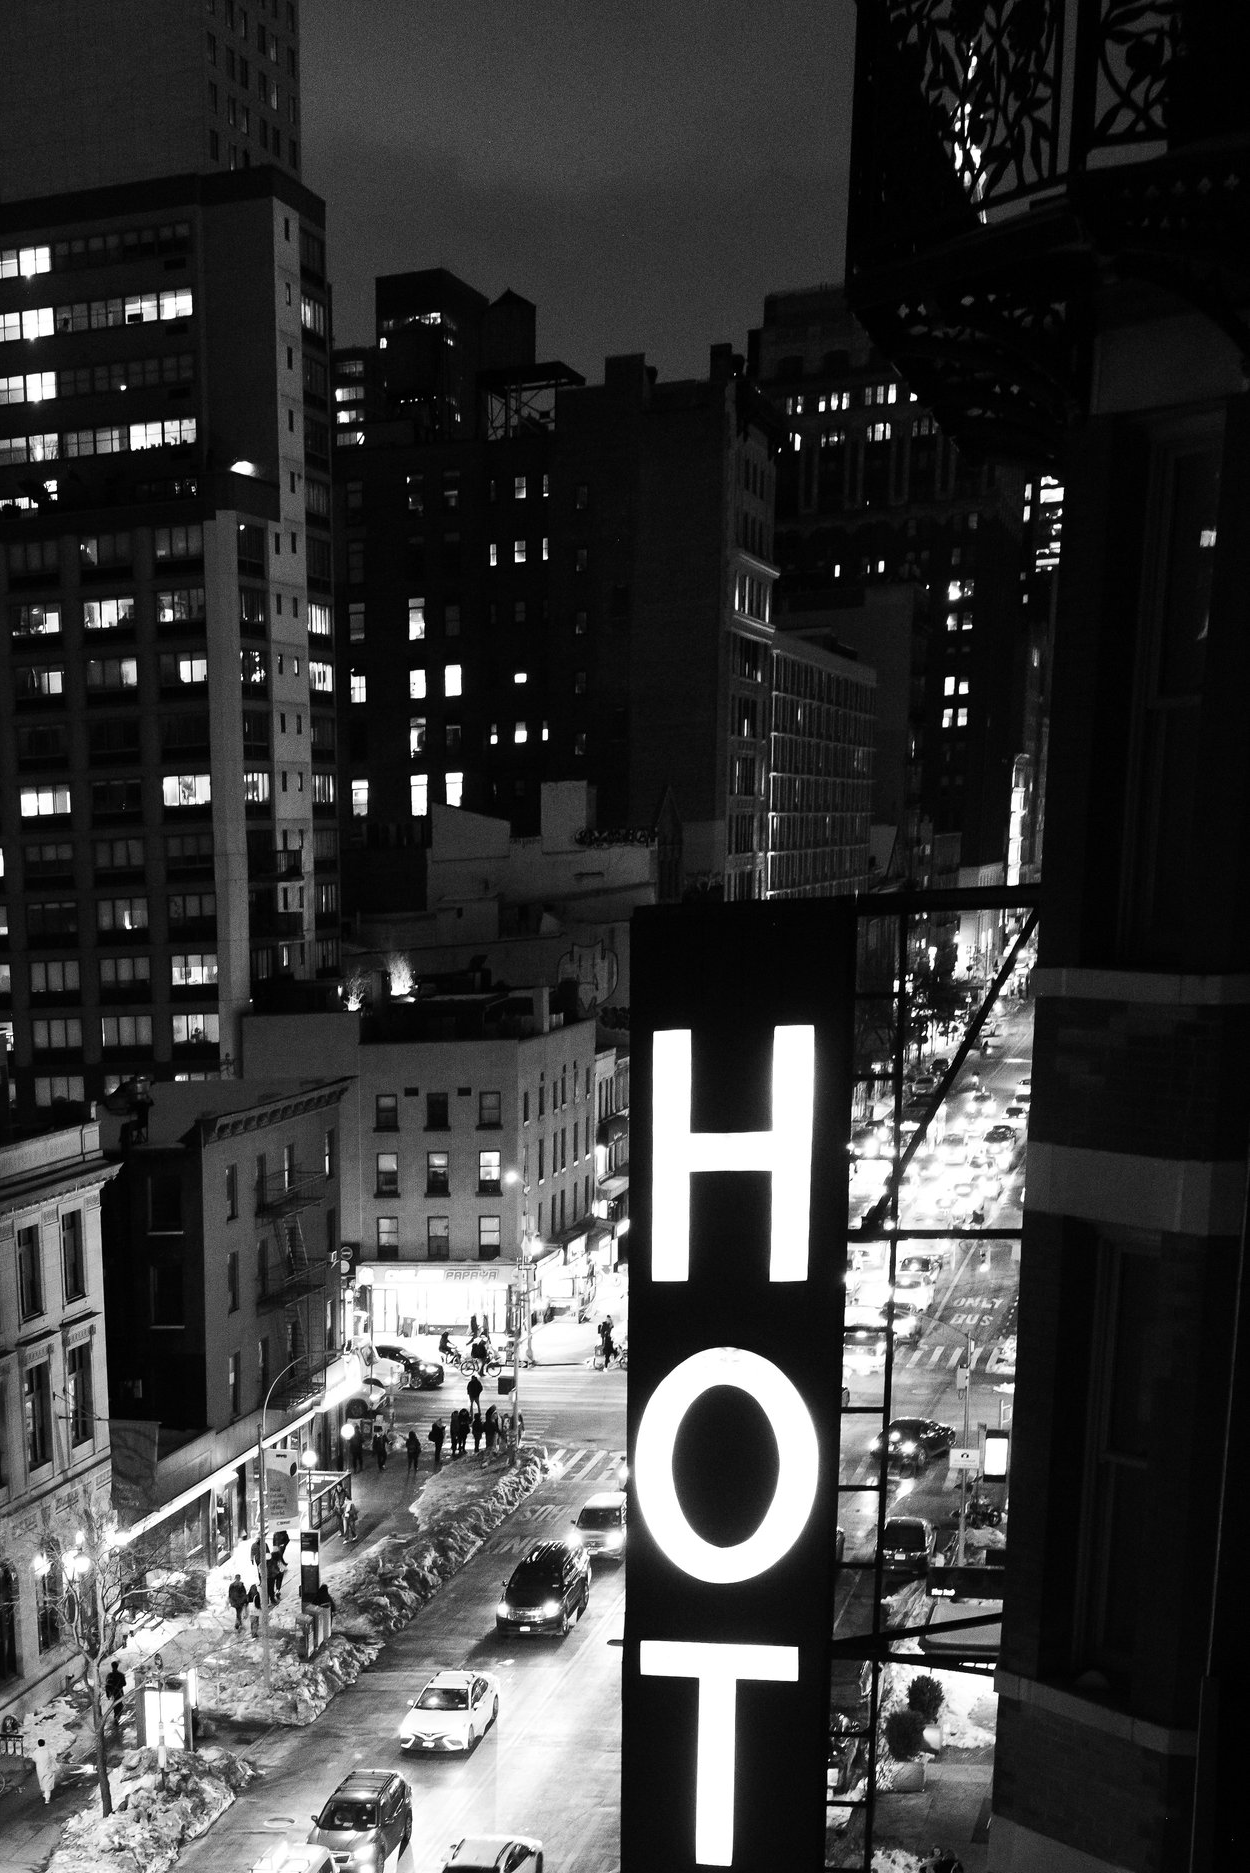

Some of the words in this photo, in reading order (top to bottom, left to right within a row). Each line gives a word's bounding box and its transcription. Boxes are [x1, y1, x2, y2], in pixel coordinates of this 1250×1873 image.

[446, 1270, 497, 1280] PAPAYA
[953, 1297, 1003, 1309] ONLY
[950, 1313, 993, 1326] BUS
